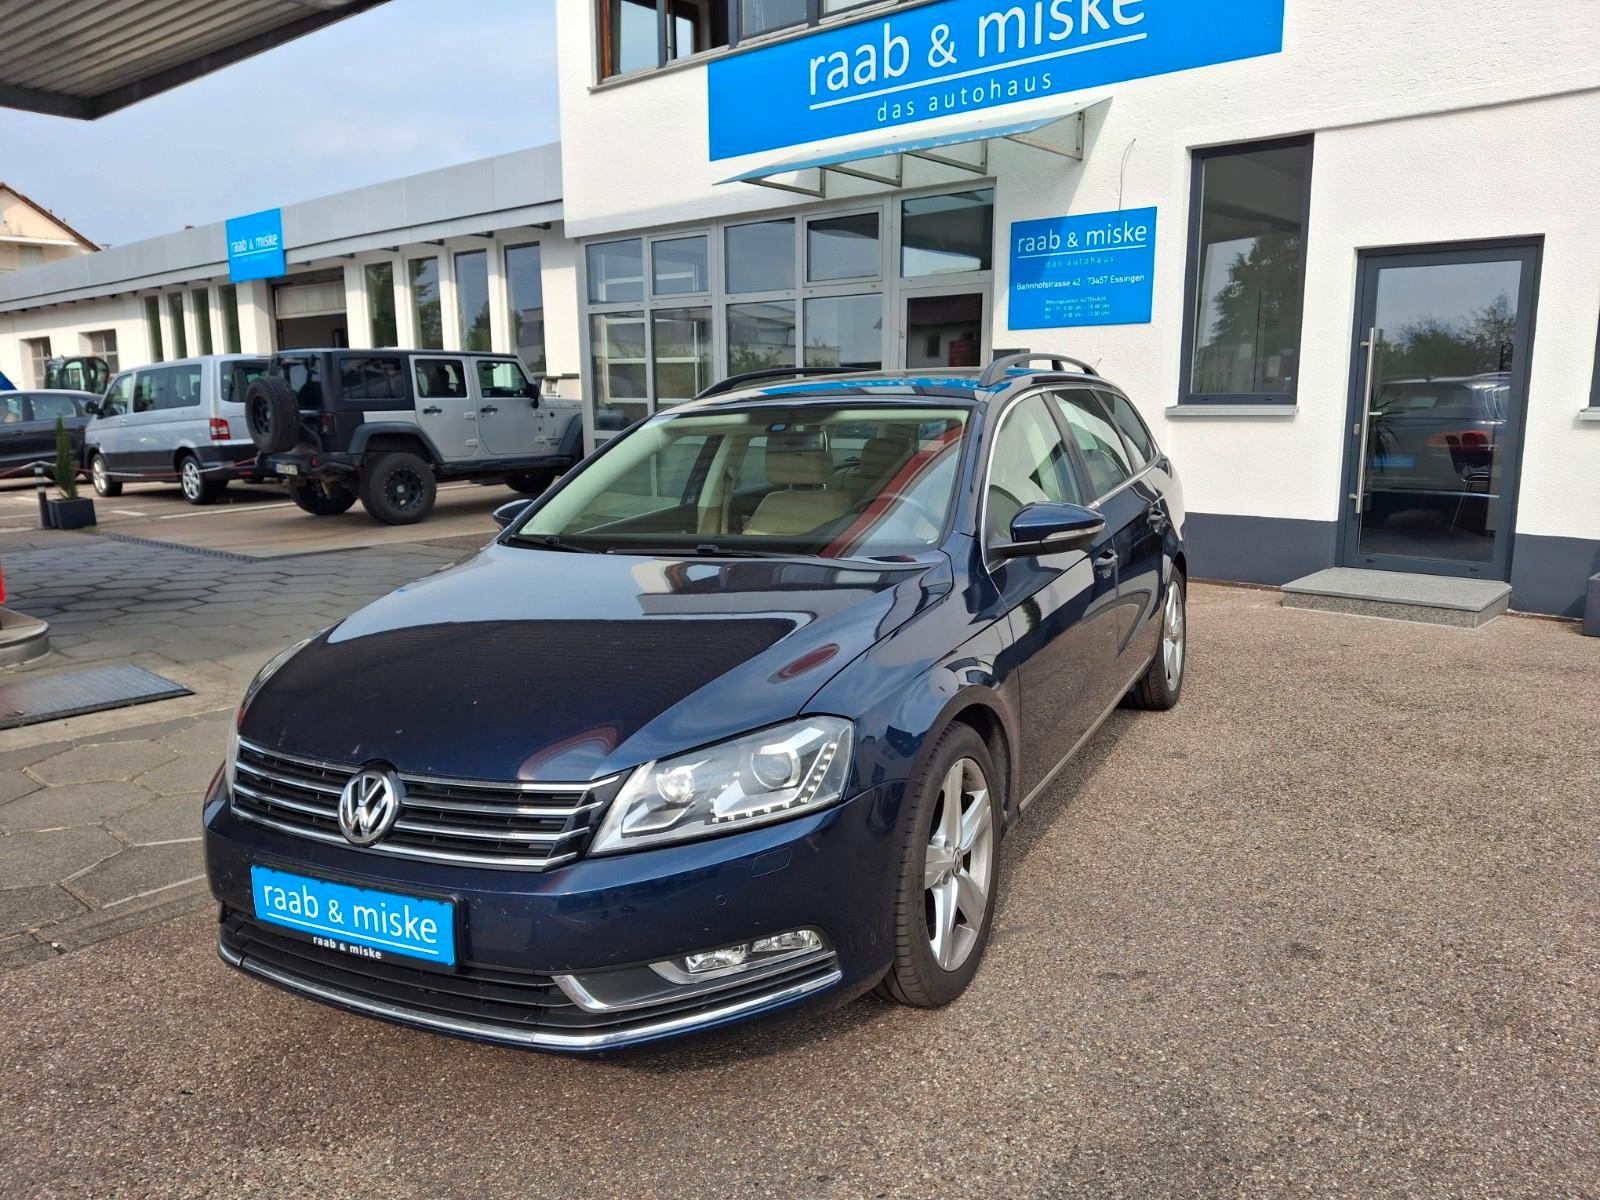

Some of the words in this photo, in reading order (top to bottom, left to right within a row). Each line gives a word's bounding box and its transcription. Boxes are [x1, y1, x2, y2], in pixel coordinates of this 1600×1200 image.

[808, 21, 910, 96] raab
[927, 24, 958, 69] &
[978, 0, 1146, 58] miske
[877, 101, 915, 123] das
[928, 70, 1053, 112] autohaus
[231, 231, 247, 253] raab
[255, 230, 278, 248] miske
[1017, 228, 1061, 253] raab
[1067, 231, 1079, 248] &
[1086, 221, 1147, 246] miske
[1045, 259, 1062, 268] das
[1066, 256, 1114, 266] autohaus
[1072, 278, 1081, 286] 42
[1087, 275, 1108, 285] 73457
[1110, 274, 1145, 285] Essingen
[263, 885, 318, 919] raab
[329, 899, 345, 925] &
[353, 902, 438, 944] miske
[312, 936, 336, 949] raab
[339, 942, 346, 951] &
[349, 945, 382, 959] miske
